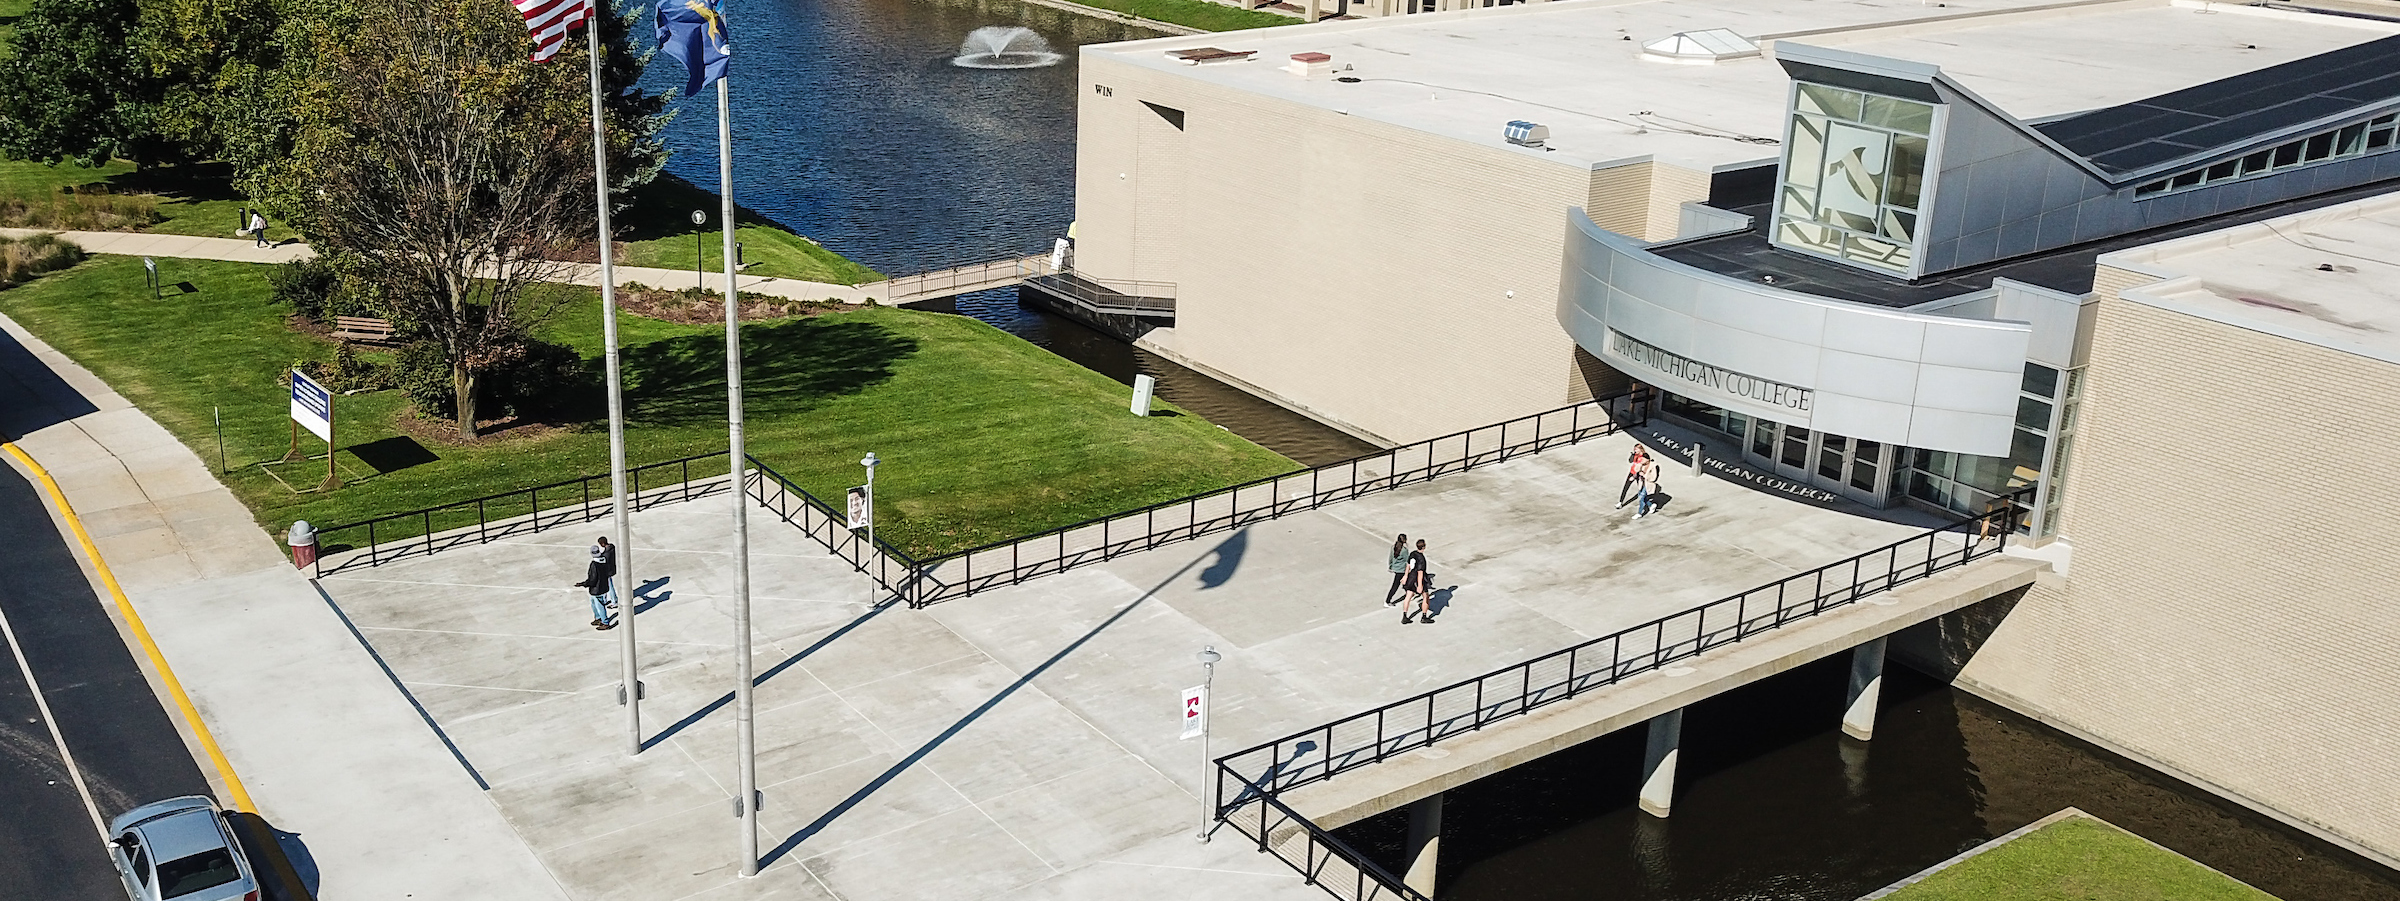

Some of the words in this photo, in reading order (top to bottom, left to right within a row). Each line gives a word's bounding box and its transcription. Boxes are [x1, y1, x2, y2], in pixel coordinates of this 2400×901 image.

[1612, 331, 1642, 362] LAKE
[1643, 348, 1723, 390] MICHIGAN
[1725, 372, 1810, 411] COLLEGE
[1680, 446, 1755, 481] MHIGAN
